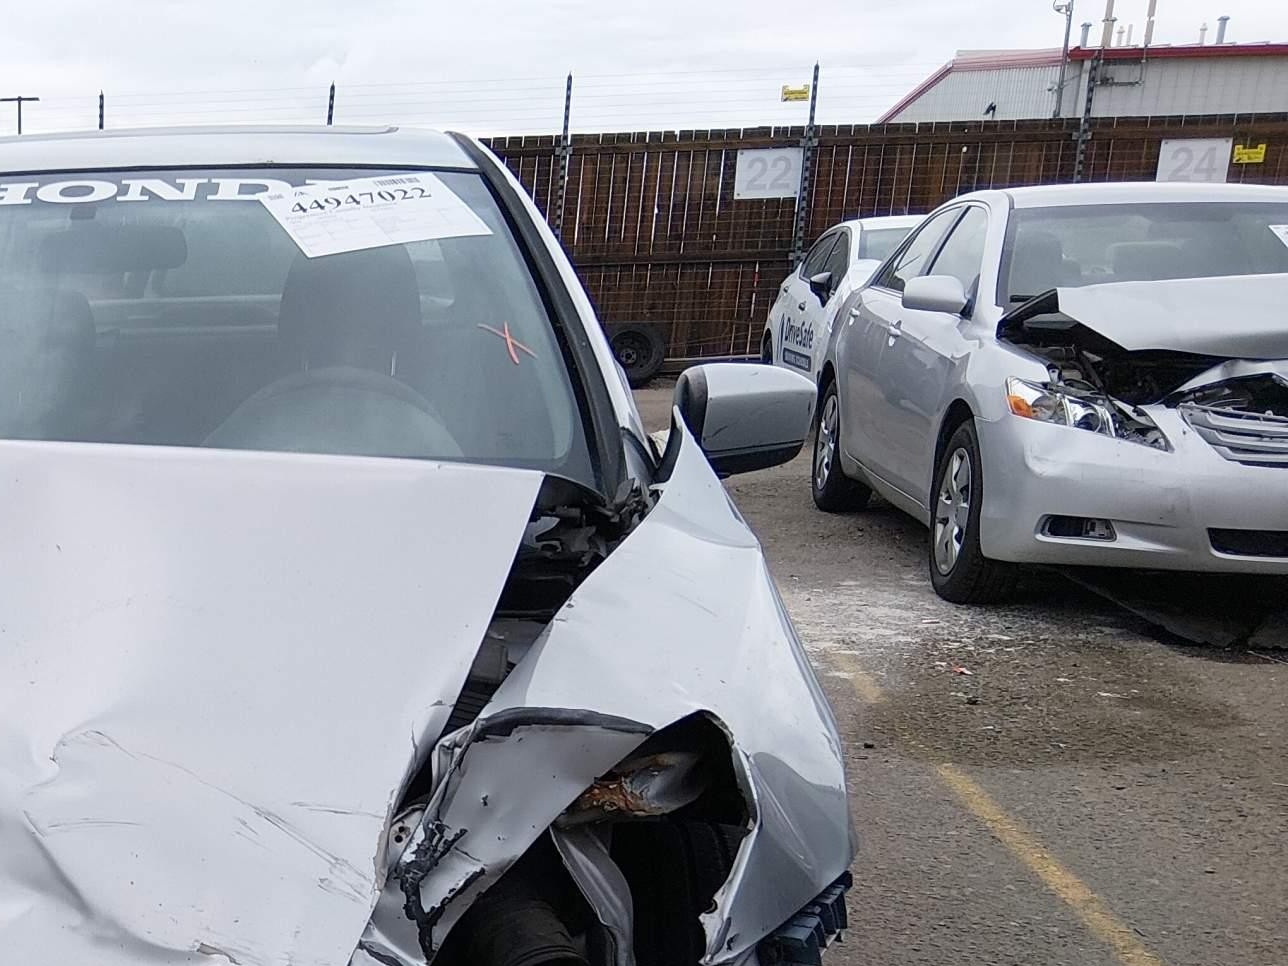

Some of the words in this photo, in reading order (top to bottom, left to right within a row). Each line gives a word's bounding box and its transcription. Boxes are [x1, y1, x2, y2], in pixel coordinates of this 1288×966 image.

[745, 155, 792, 191] 22
[1168, 146, 1217, 183] 24
[291, 186, 433, 214] 44947022
